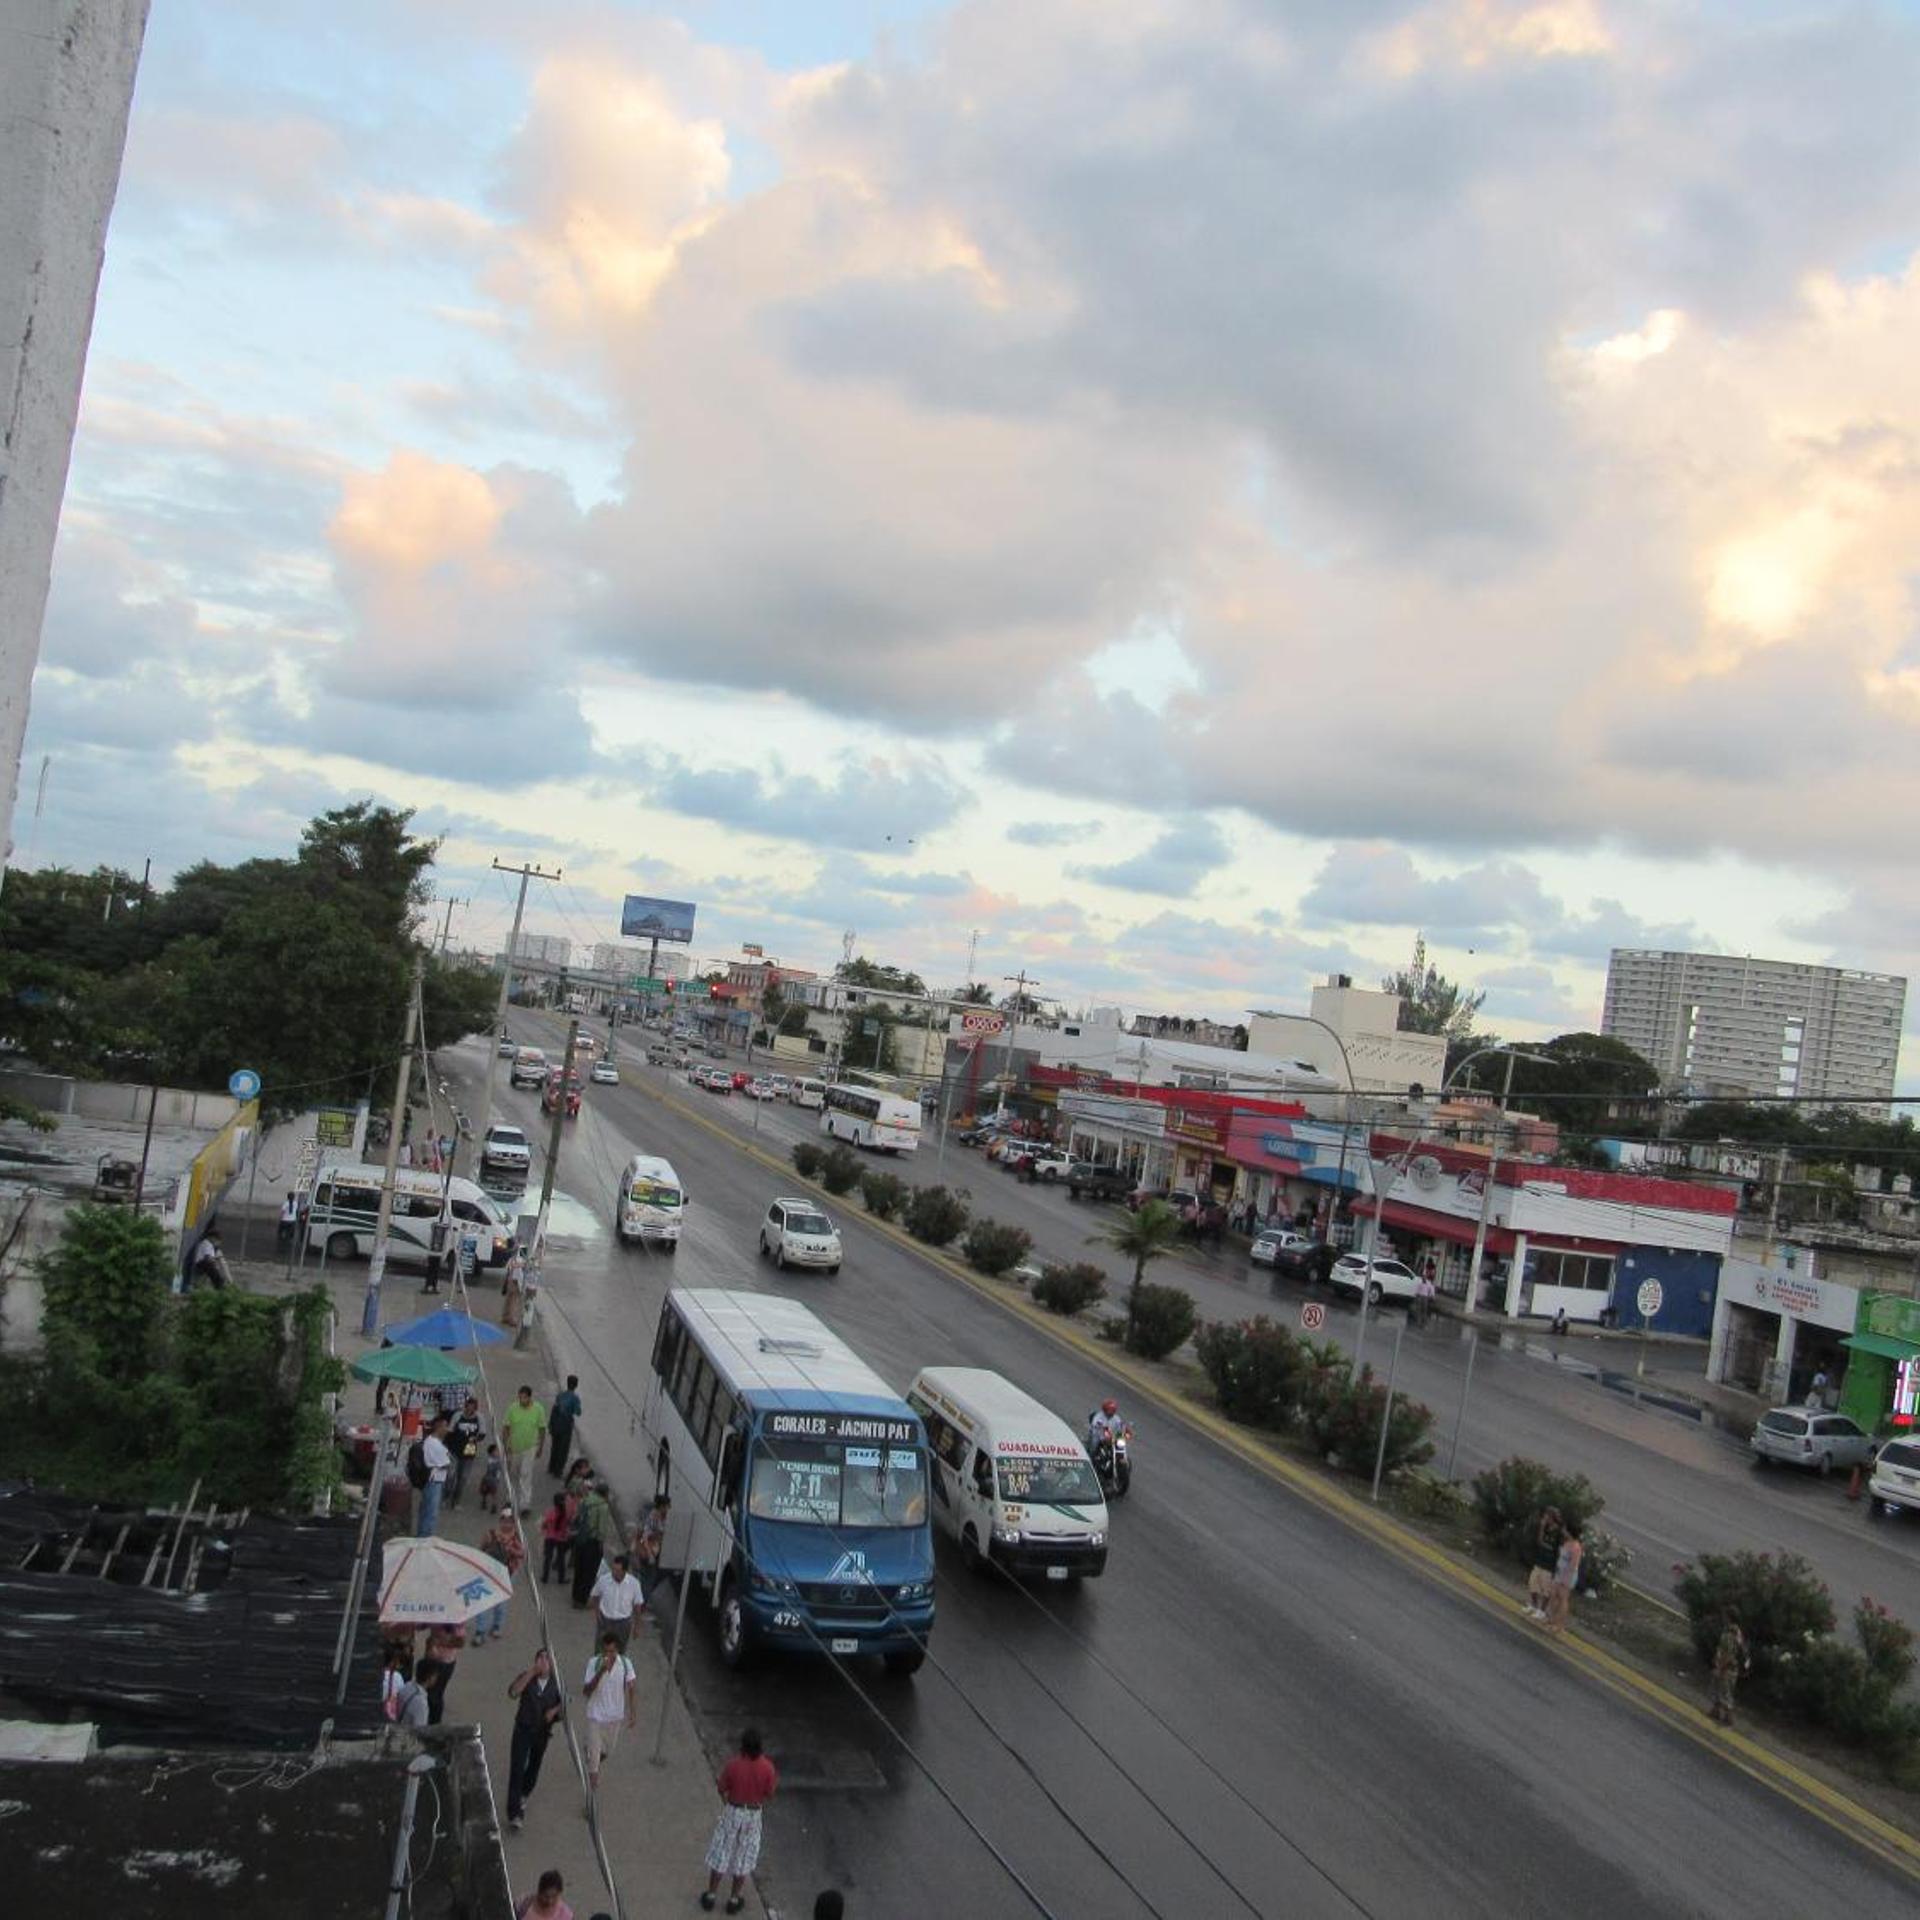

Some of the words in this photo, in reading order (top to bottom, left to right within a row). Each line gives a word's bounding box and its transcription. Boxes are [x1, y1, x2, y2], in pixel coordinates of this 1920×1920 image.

[966, 1016, 1000, 1032] OXXO
[773, 1415, 827, 1434] CORALES
[836, 1419, 884, 1438] JACINTO
[888, 1423, 911, 1440] PAT
